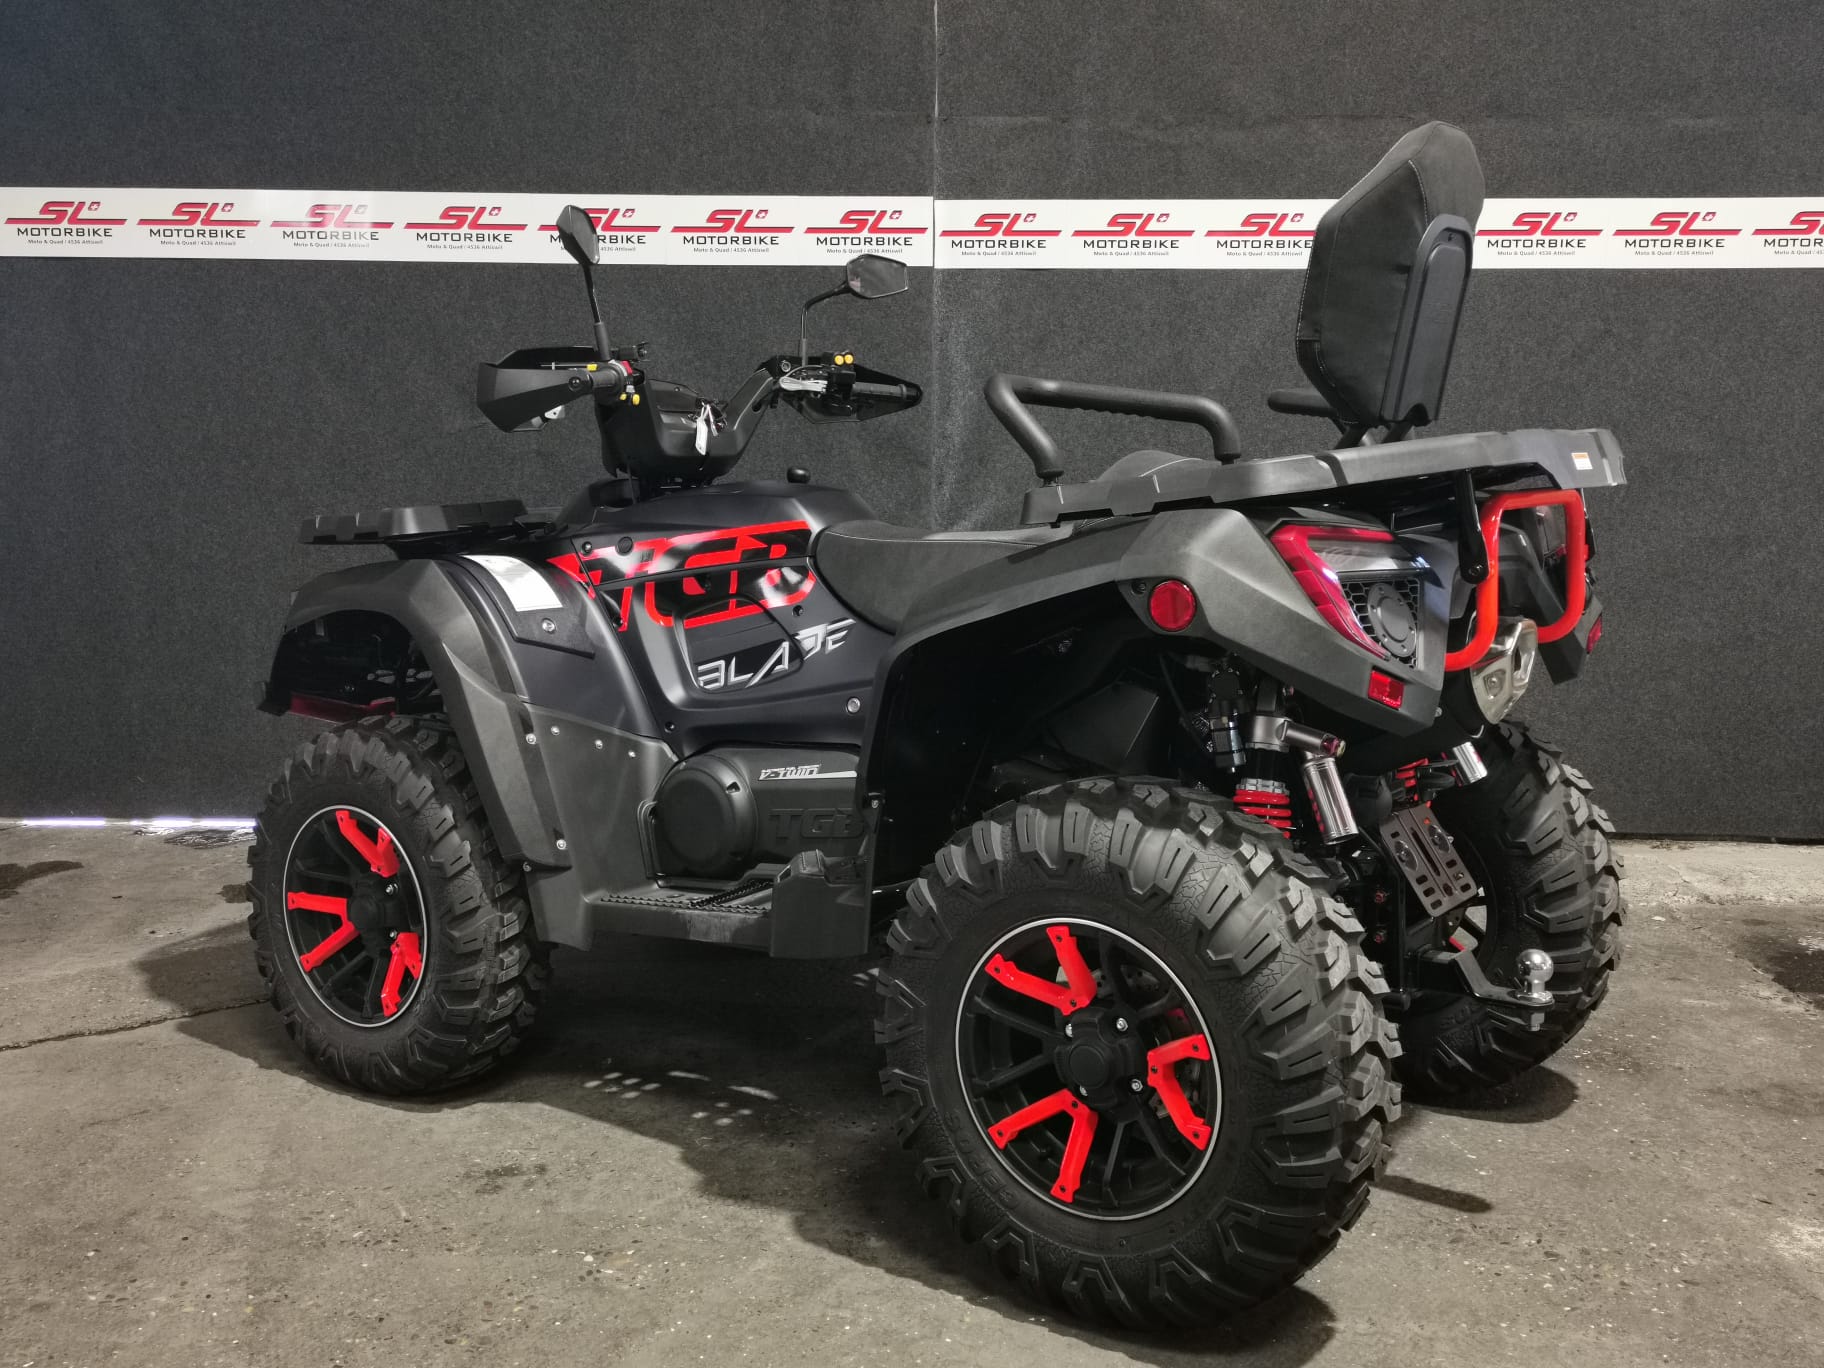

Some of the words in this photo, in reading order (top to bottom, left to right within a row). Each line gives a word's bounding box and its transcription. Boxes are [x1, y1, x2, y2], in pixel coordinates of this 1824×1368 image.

[17, 228, 113, 237] MOTORBIKE
[150, 229, 246, 238] MOTORBIKE
[282, 230, 379, 240] MOTORBIKE
[417, 233, 513, 242] MOTORBIKE
[550, 235, 646, 244] MRBIKE
[683, 236, 779, 245] MOTORBIKE
[817, 237, 913, 246] MOTORBIKE
[952, 240, 1046, 249] MOTORBIKE
[1083, 240, 1180, 248] MOTORBIKE
[1217, 240, 1312, 248] MOTORBIKE
[1488, 239, 1587, 248] MOTORBIKE
[1625, 239, 1725, 248] MOTORBIKE
[546, 520, 816, 632] TGB
[698, 618, 856, 690] BLADE
[768, 808, 864, 838] TGB
